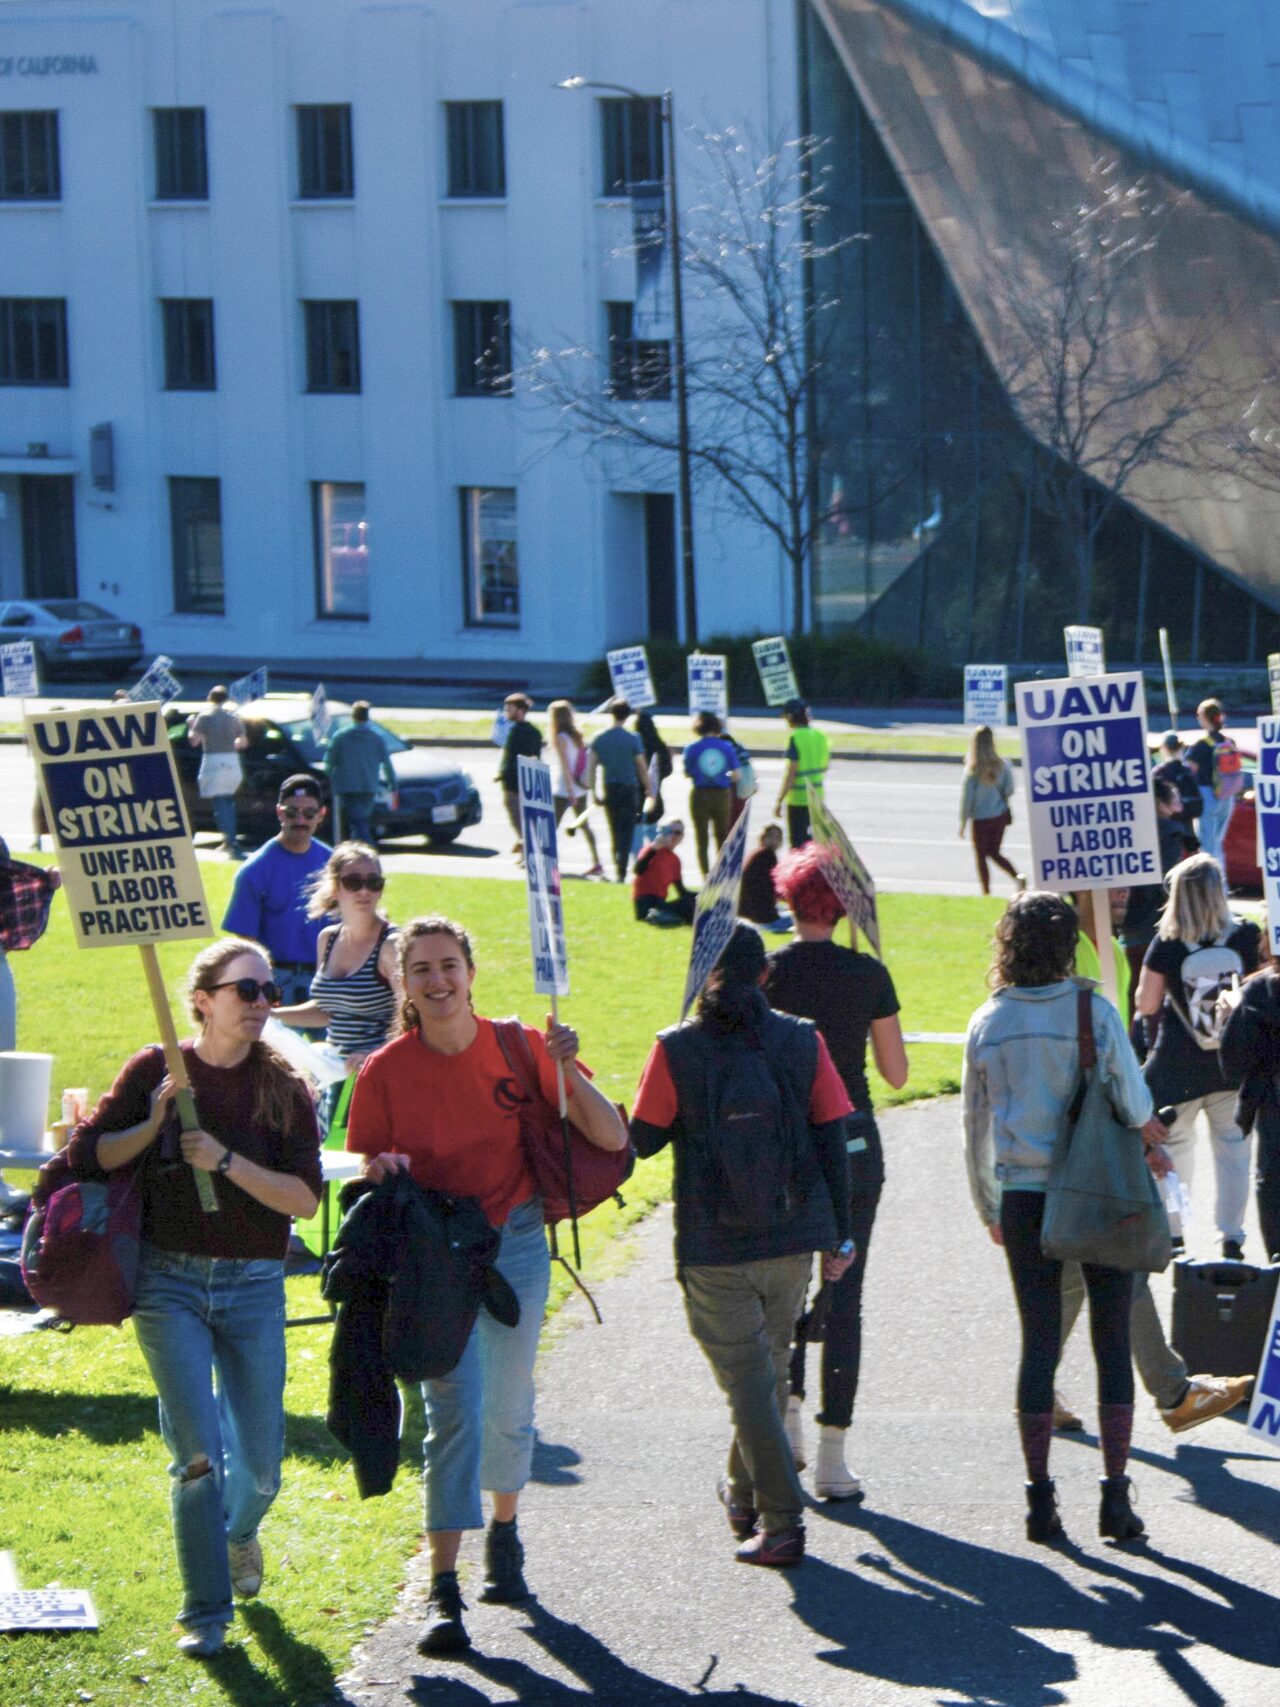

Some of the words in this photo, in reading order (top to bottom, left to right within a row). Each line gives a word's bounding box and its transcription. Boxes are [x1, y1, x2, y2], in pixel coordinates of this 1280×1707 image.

[1024, 682, 1137, 720] UAW
[33, 712, 157, 756] UAW
[1062, 727, 1107, 758] ON
[83, 763, 133, 800] ON
[521, 766, 552, 804] UAW
[1034, 759, 1144, 795] STRIKE
[58, 799, 180, 840] STRIKE
[1050, 801, 1135, 827] UNFAIR
[1057, 827, 1133, 853] LABOR
[80, 845, 175, 876] UNFAIR
[1041, 851, 1154, 881] PRACTICE
[92, 875, 177, 905] LABOR
[79, 902, 205, 935] PRACTICE
